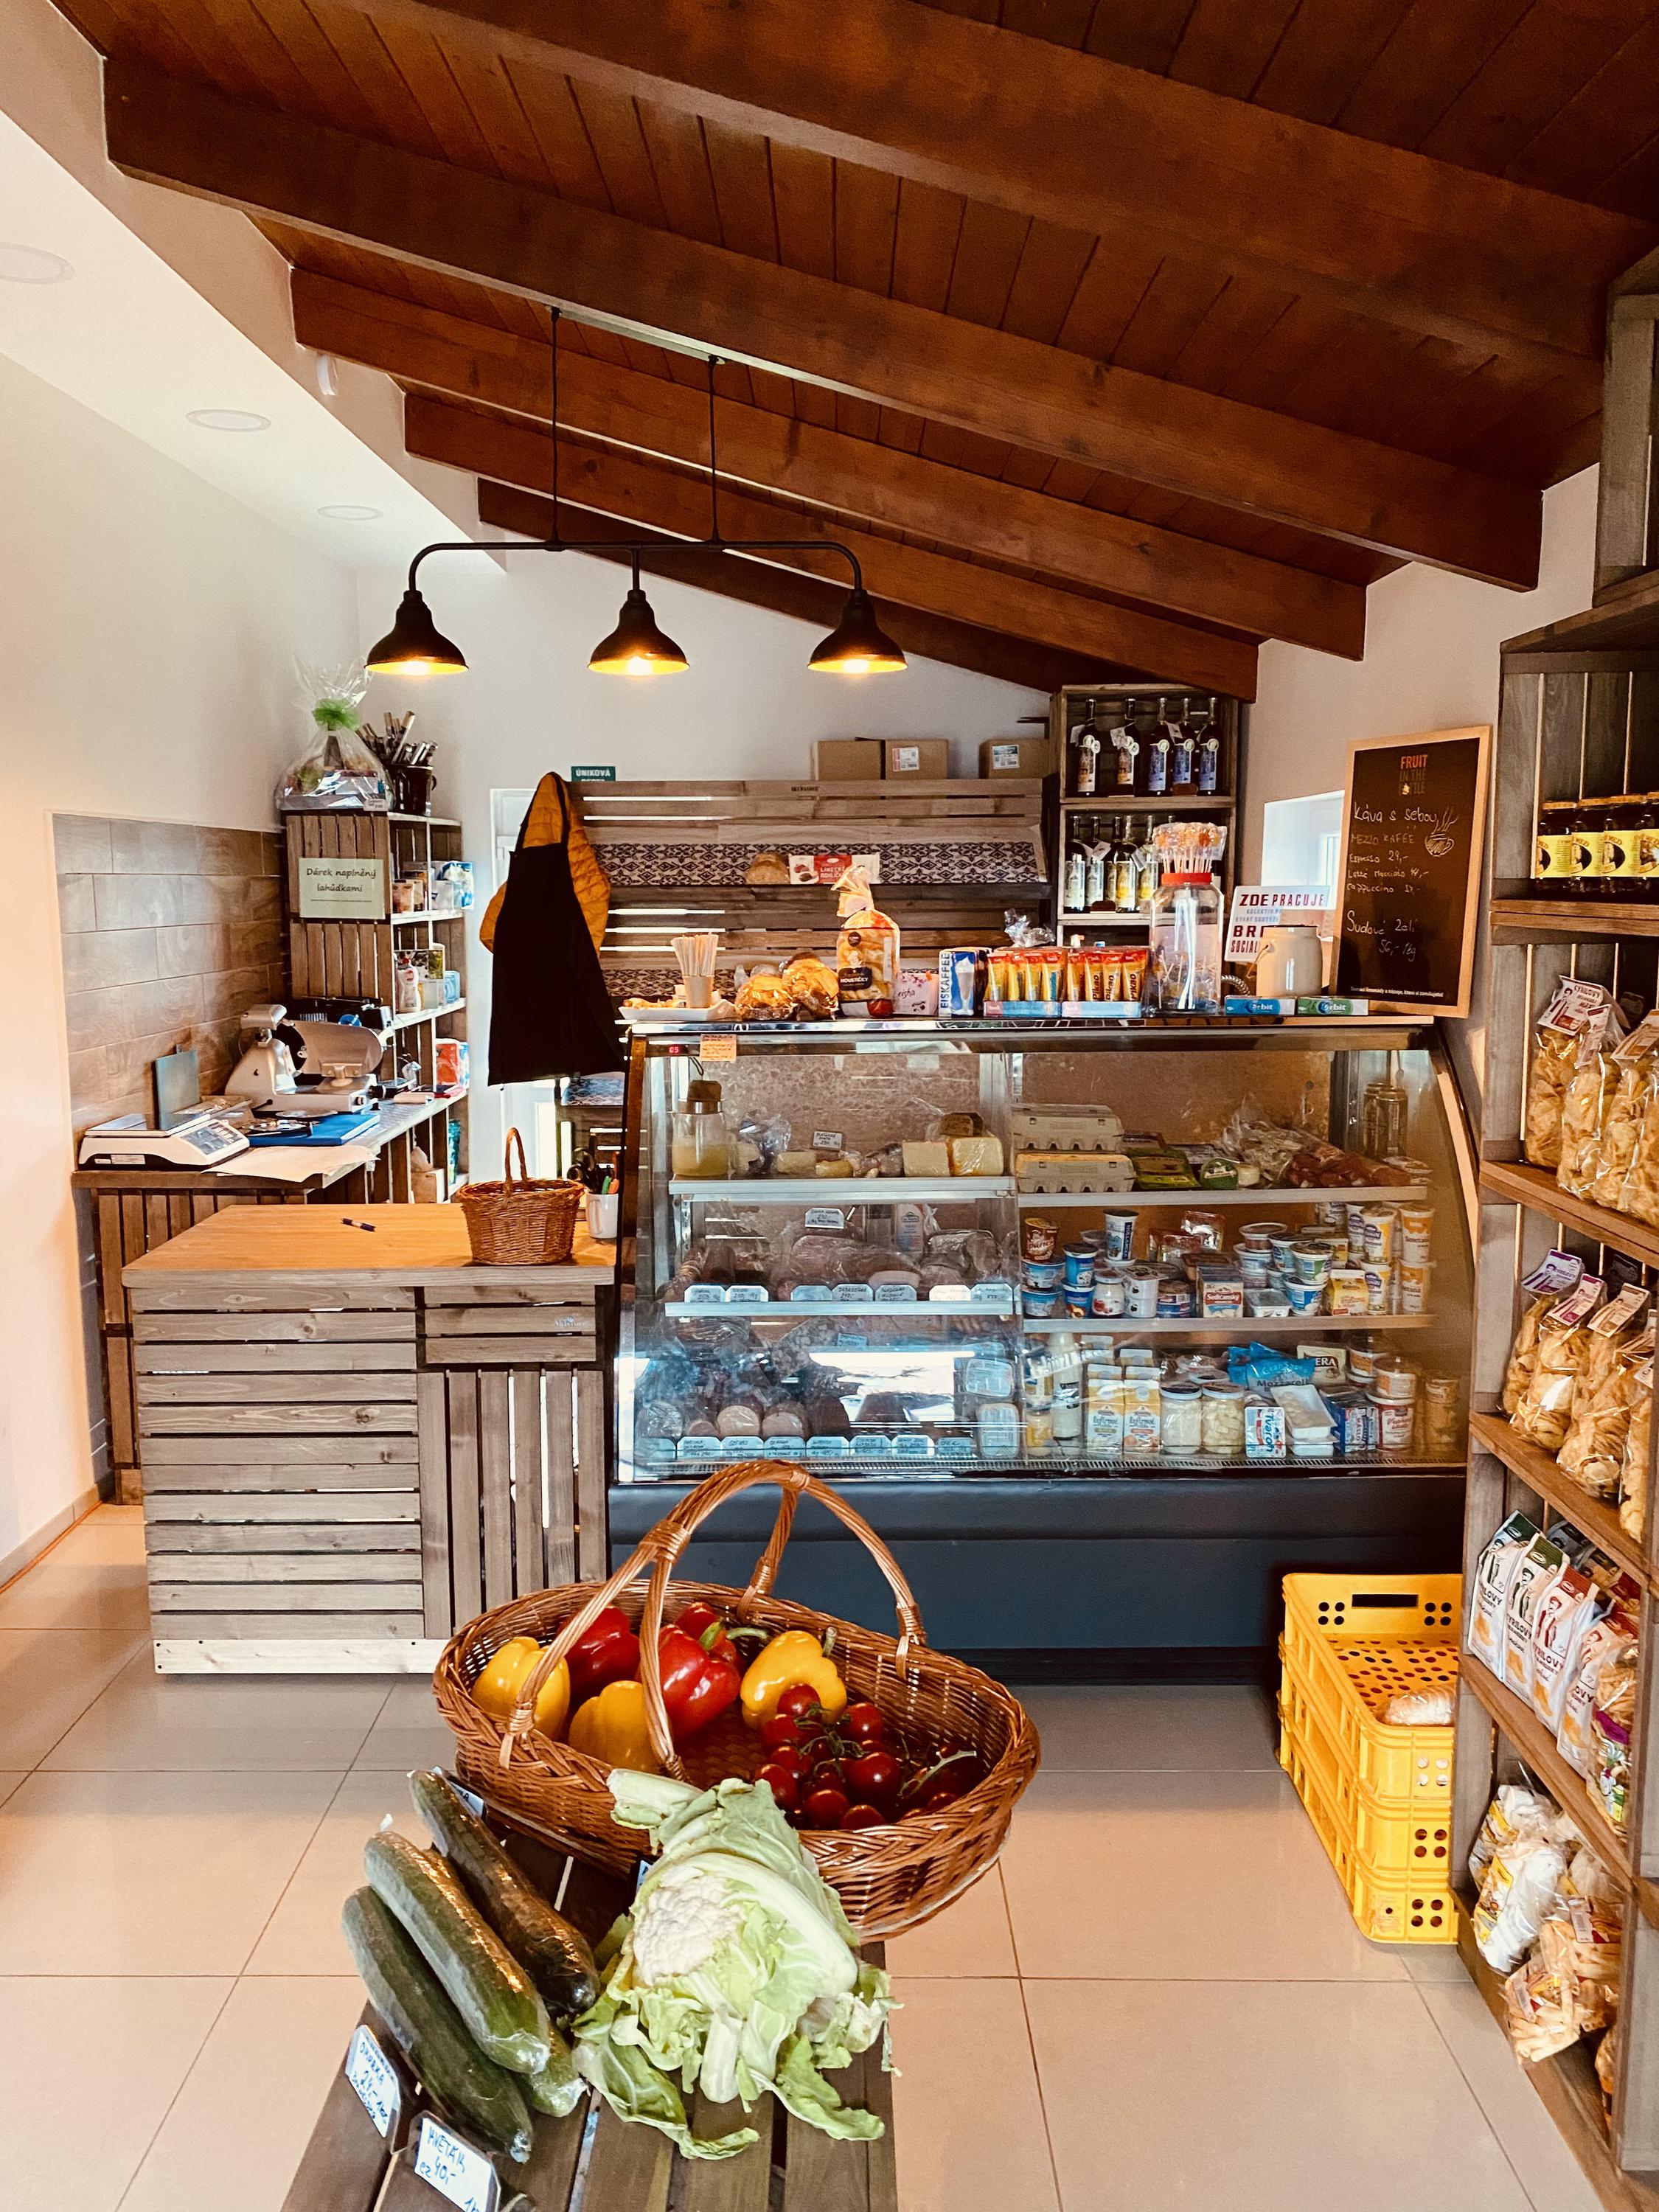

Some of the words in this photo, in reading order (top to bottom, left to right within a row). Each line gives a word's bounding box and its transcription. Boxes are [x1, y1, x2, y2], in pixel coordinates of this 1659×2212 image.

[1401, 754, 1428, 769] FRUIT
[576, 768, 611, 777] ÚNIKOVÁ
[1411, 768, 1426, 780] THE
[1354, 802, 1383, 823] Káva
[307, 868, 333, 877] Dárek
[335, 869, 376, 879] naplněný
[317, 883, 362, 892] lahůdkami
[1239, 894, 1269, 906] ZDE
[1273, 894, 1324, 906] PRACUJE
[940, 953, 950, 1009] EISKAFFEE
[1315, 1357, 1335, 1366] ERA
[1265, 1413, 1274, 1452] Tvaroh
